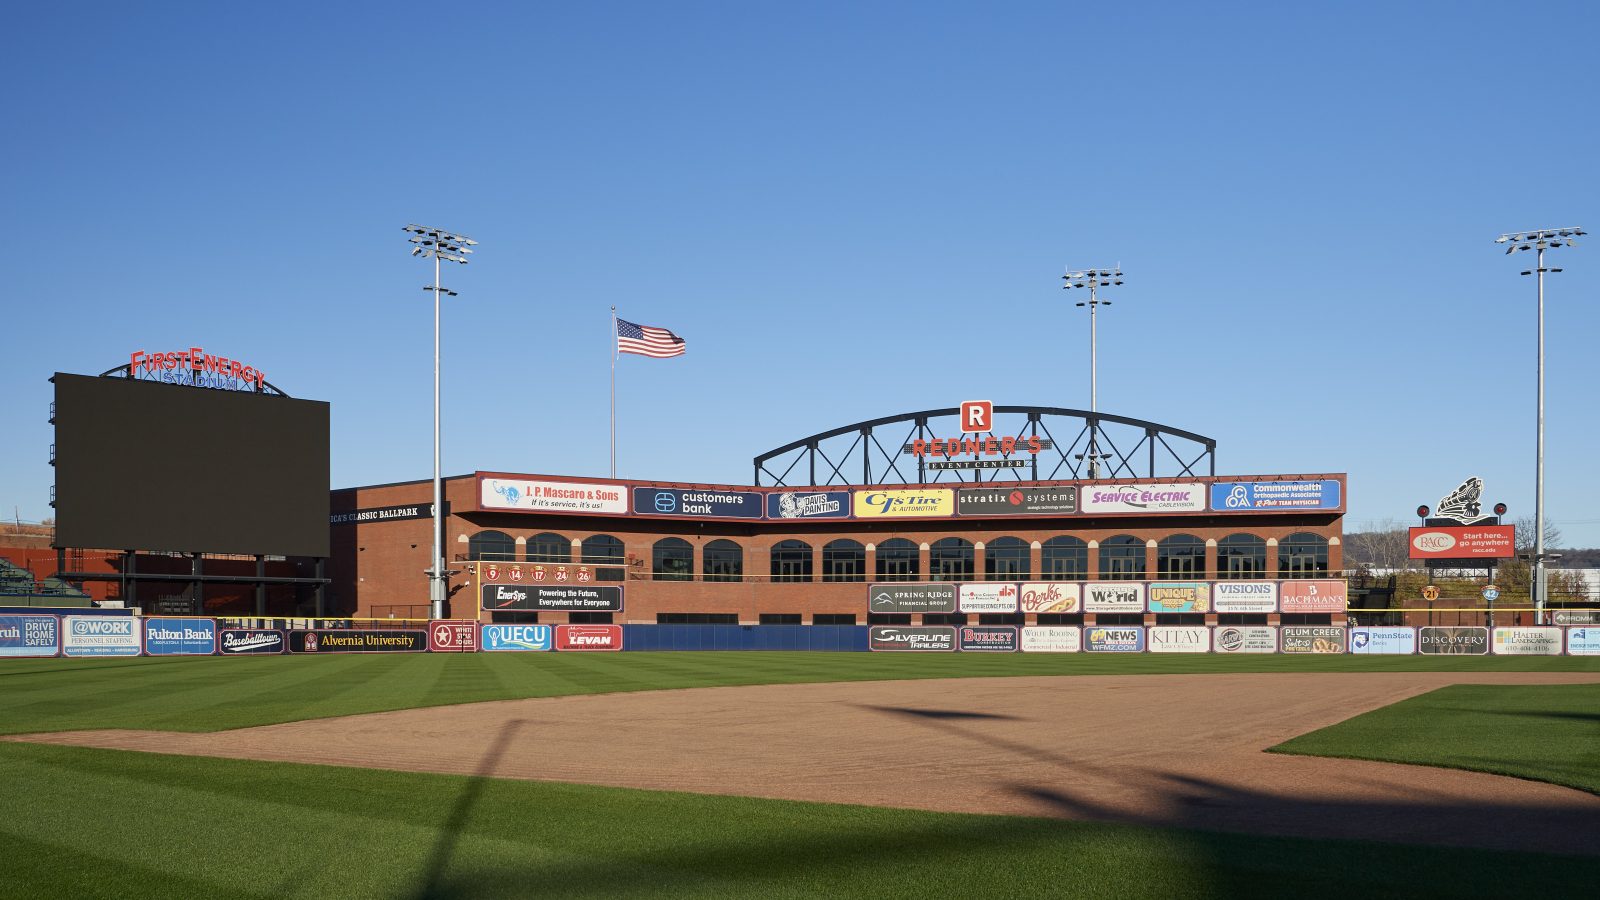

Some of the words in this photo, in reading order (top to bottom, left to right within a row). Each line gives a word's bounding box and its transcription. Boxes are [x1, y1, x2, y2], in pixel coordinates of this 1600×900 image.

[163, 372, 237, 391] STADIUM
[969, 405, 984, 426] R
[913, 435, 1041, 457] REDNER'S
[974, 460, 1022, 468] CENTER
[1253, 484, 1322, 492] Commonwealth
[544, 487, 585, 500] Mascaro
[587, 490, 594, 500] &
[596, 490, 619, 501] Sons
[682, 493, 744, 504] customers
[960, 494, 1006, 503] stratix
[1027, 494, 1074, 503] systems
[1092, 491, 1138, 503] SERVICE
[1140, 490, 1190, 502] ELECTRIC
[550, 501, 578, 509] service,
[805, 495, 826, 506] DAVIS
[904, 496, 942, 504] Tire
[682, 504, 712, 514] bank
[804, 502, 839, 514] PAINTING
[349, 511, 378, 520] CLASSIC
[379, 508, 418, 518] BALLPARK
[490, 570, 496, 578] 9
[511, 571, 521, 579] 14
[557, 572, 567, 580] 24
[497, 587, 527, 601] EnerSys
[578, 590, 599, 598] Future,
[1151, 588, 1196, 601] UNIQUE
[1219, 584, 1271, 594] VISIONS
[1308, 585, 1317, 595] B
[1485, 590, 1496, 598] 42
[1022, 583, 1062, 611] Berks
[1091, 589, 1138, 603] World
[1284, 595, 1343, 604] BACHMAN'S
[25, 623, 54, 631] DRIVE
[74, 621, 130, 634] @WORK
[25, 631, 54, 639] HOME
[148, 629, 183, 640] Fulton
[184, 629, 213, 640] Bank
[224, 633, 278, 646] Baseballtown
[500, 626, 545, 642] UECU
[874, 629, 951, 642] SILVERLINE
[964, 630, 1013, 641] BURKEY
[1106, 631, 1137, 640] NEWS
[1153, 631, 1203, 643] KITAY
[321, 635, 363, 646] Alvernia
[366, 635, 414, 648] University
[569, 636, 611, 645] LEVAN
[911, 641, 949, 649] TRAILERS
[1423, 636, 1485, 645] DISCOVERY
